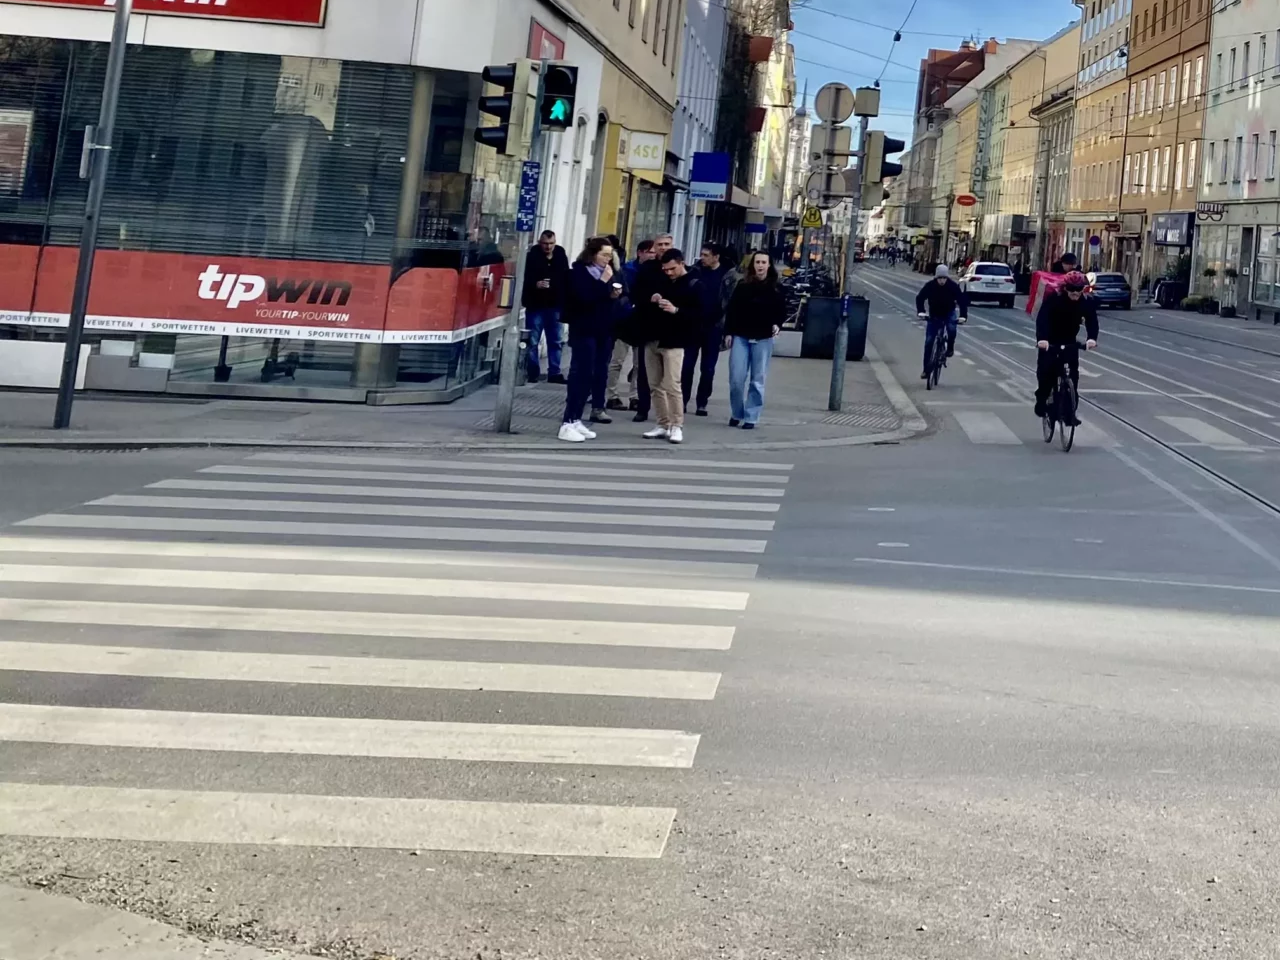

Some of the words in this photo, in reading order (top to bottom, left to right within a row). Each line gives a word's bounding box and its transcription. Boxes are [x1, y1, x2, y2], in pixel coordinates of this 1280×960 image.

[198, 264, 353, 308] tipwin
[0, 314, 60, 324] PORTWETTEN
[86, 319, 134, 328] VEWETTEN
[151, 322, 216, 332] SPORTWETTEN
[235, 326, 291, 336] LIVEWETTEN
[307, 330, 371, 340] SPORTWETTEN
[255, 309, 350, 322] YOURTIP-YOURWIN
